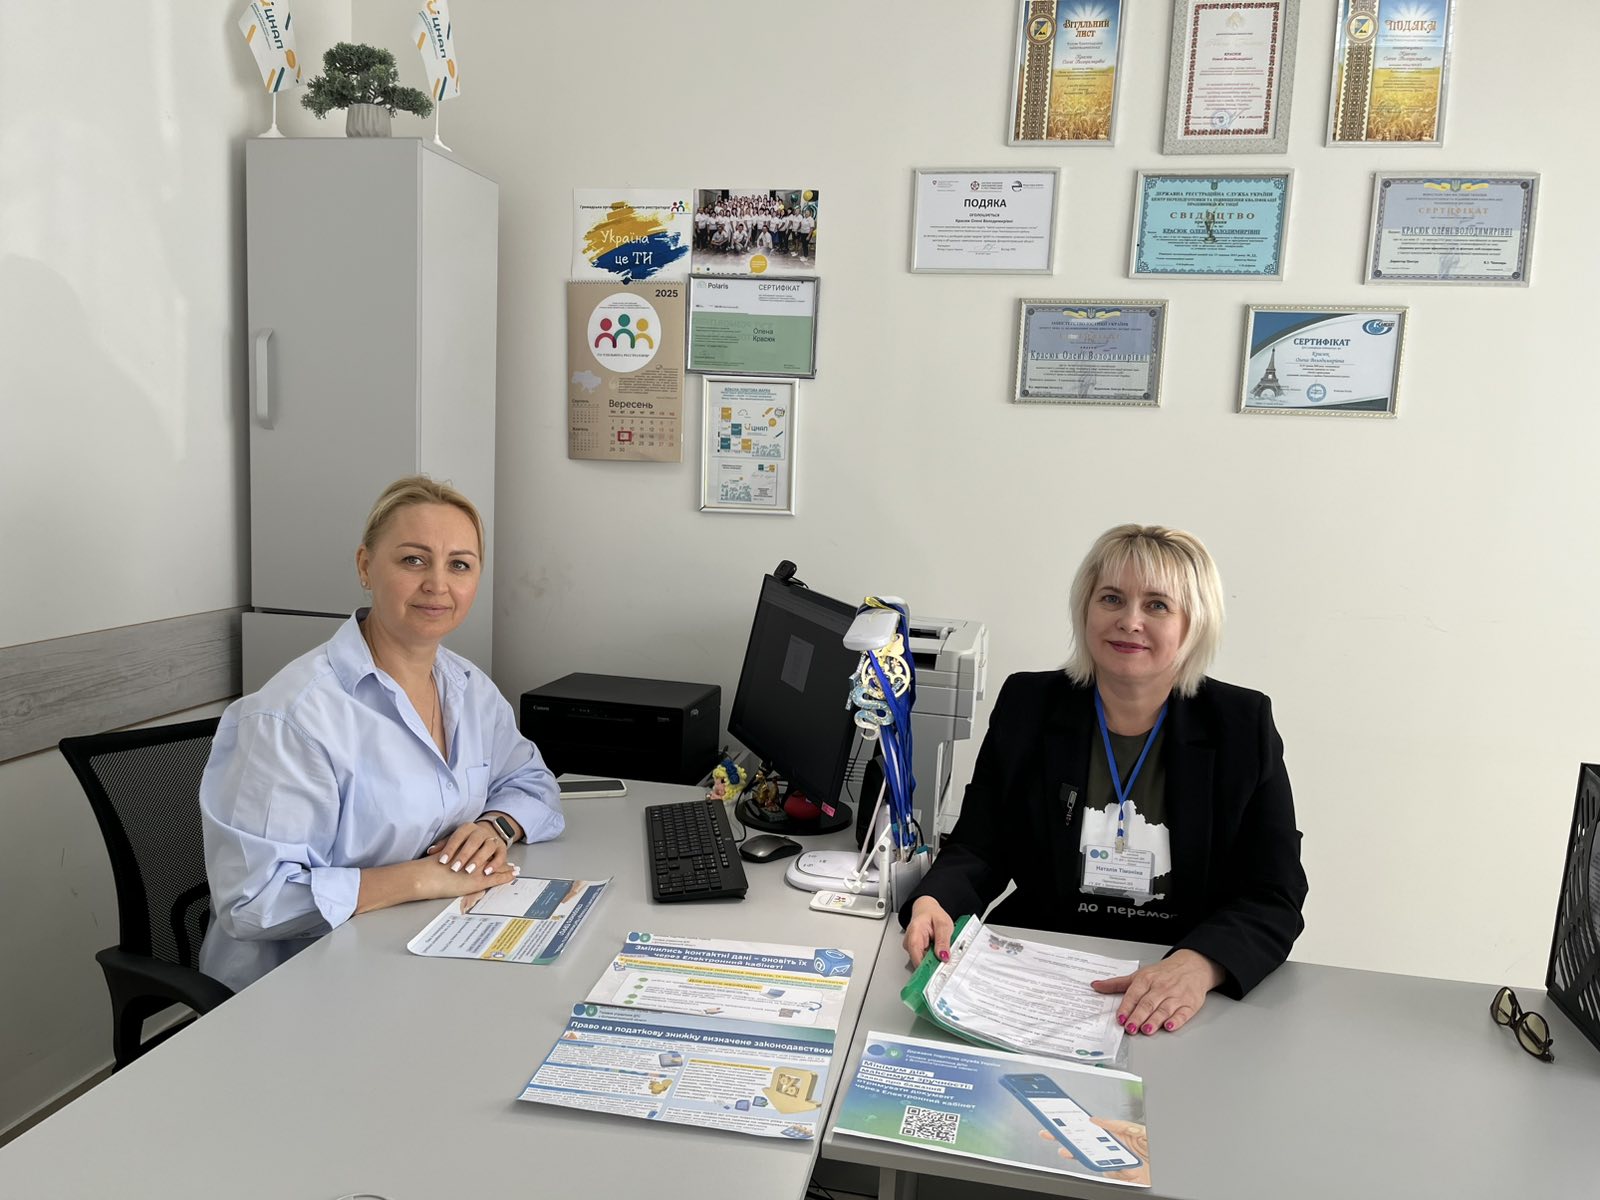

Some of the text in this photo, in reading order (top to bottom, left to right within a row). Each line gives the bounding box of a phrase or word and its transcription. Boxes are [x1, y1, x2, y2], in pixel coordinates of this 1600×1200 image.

[964, 199, 1007, 209] ПОДЯКА
[600, 229, 650, 247] Україна
[615, 251, 653, 265] це ТИ
[708, 282, 729, 290] Polaris
[1293, 338, 1351, 346] СЕРТИФІКАТ
[609, 400, 653, 409] Вересень
[635, 945, 682, 955] Змінились
[684, 949, 730, 959] контактні
[762, 957, 796, 965] оновіть
[571, 1021, 599, 1030] Право
[615, 1027, 663, 1037] податкову
[665, 1032, 701, 1041] знижку
[703, 1036, 752, 1046] визначене
[754, 1040, 833, 1054] законодавством
[864, 1061, 907, 1073] Мінімум
[861, 1068, 915, 1081] максимум
[855, 1084, 880, 1092] через
[942, 1101, 976, 1110] кабінет
[857, 1080, 954, 1101] отримувати документ
